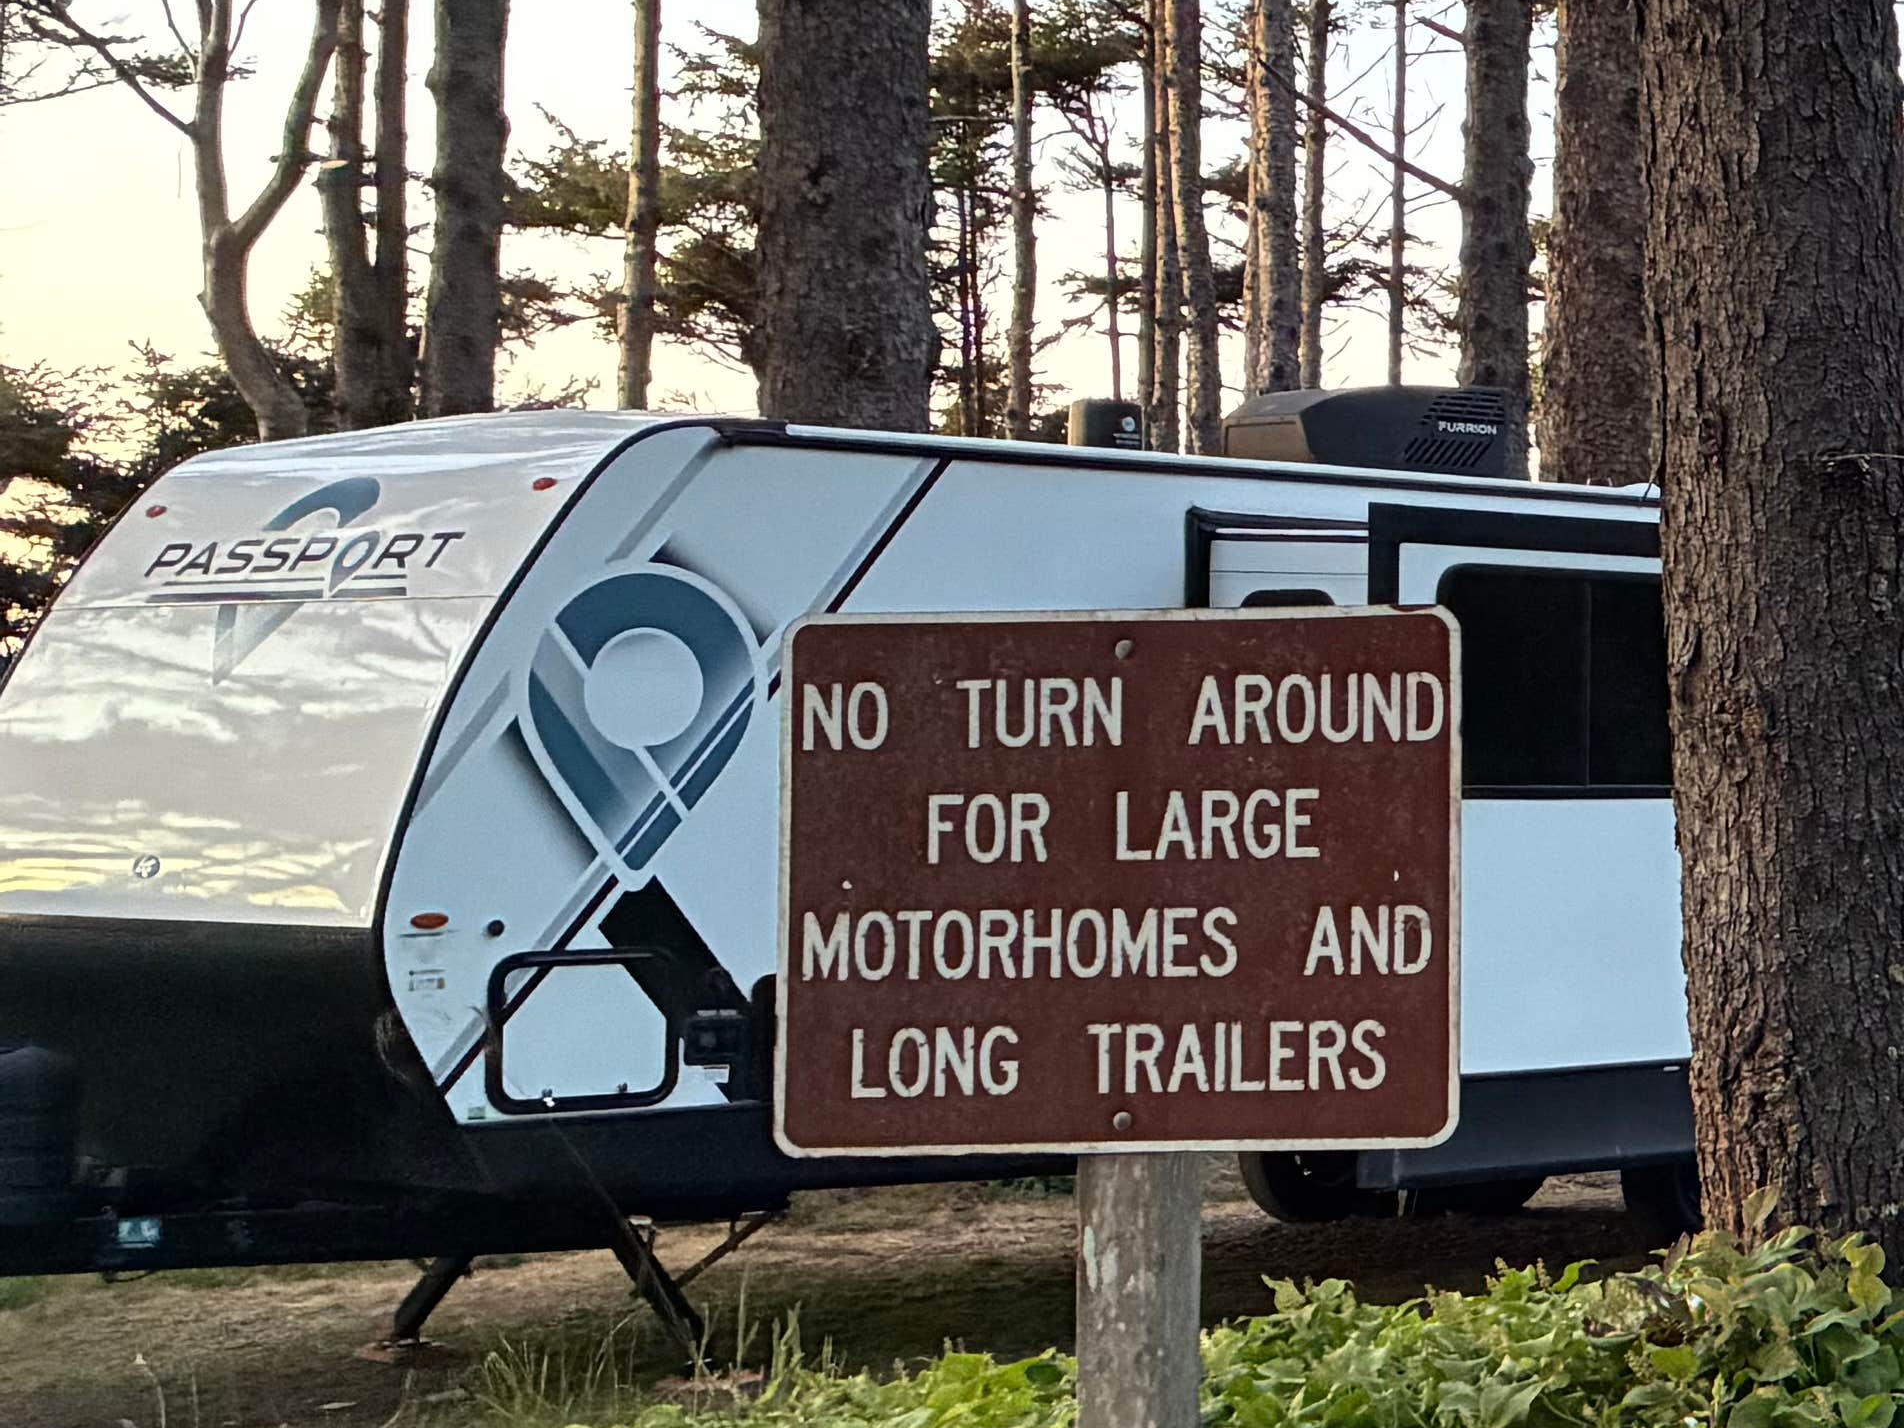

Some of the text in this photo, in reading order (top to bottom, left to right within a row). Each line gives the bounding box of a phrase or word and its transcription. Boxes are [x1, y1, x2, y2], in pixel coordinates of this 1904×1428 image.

[1438, 421, 1498, 435] FURRION
[144, 530, 466, 586] PASSPORT
[802, 672, 1444, 751] NO TURN AROUND
[927, 788, 1321, 864] FOR LARGE
[802, 904, 1432, 981] MOTORHOMES AND
[851, 1019, 1386, 1099] LONG TRAILERS
